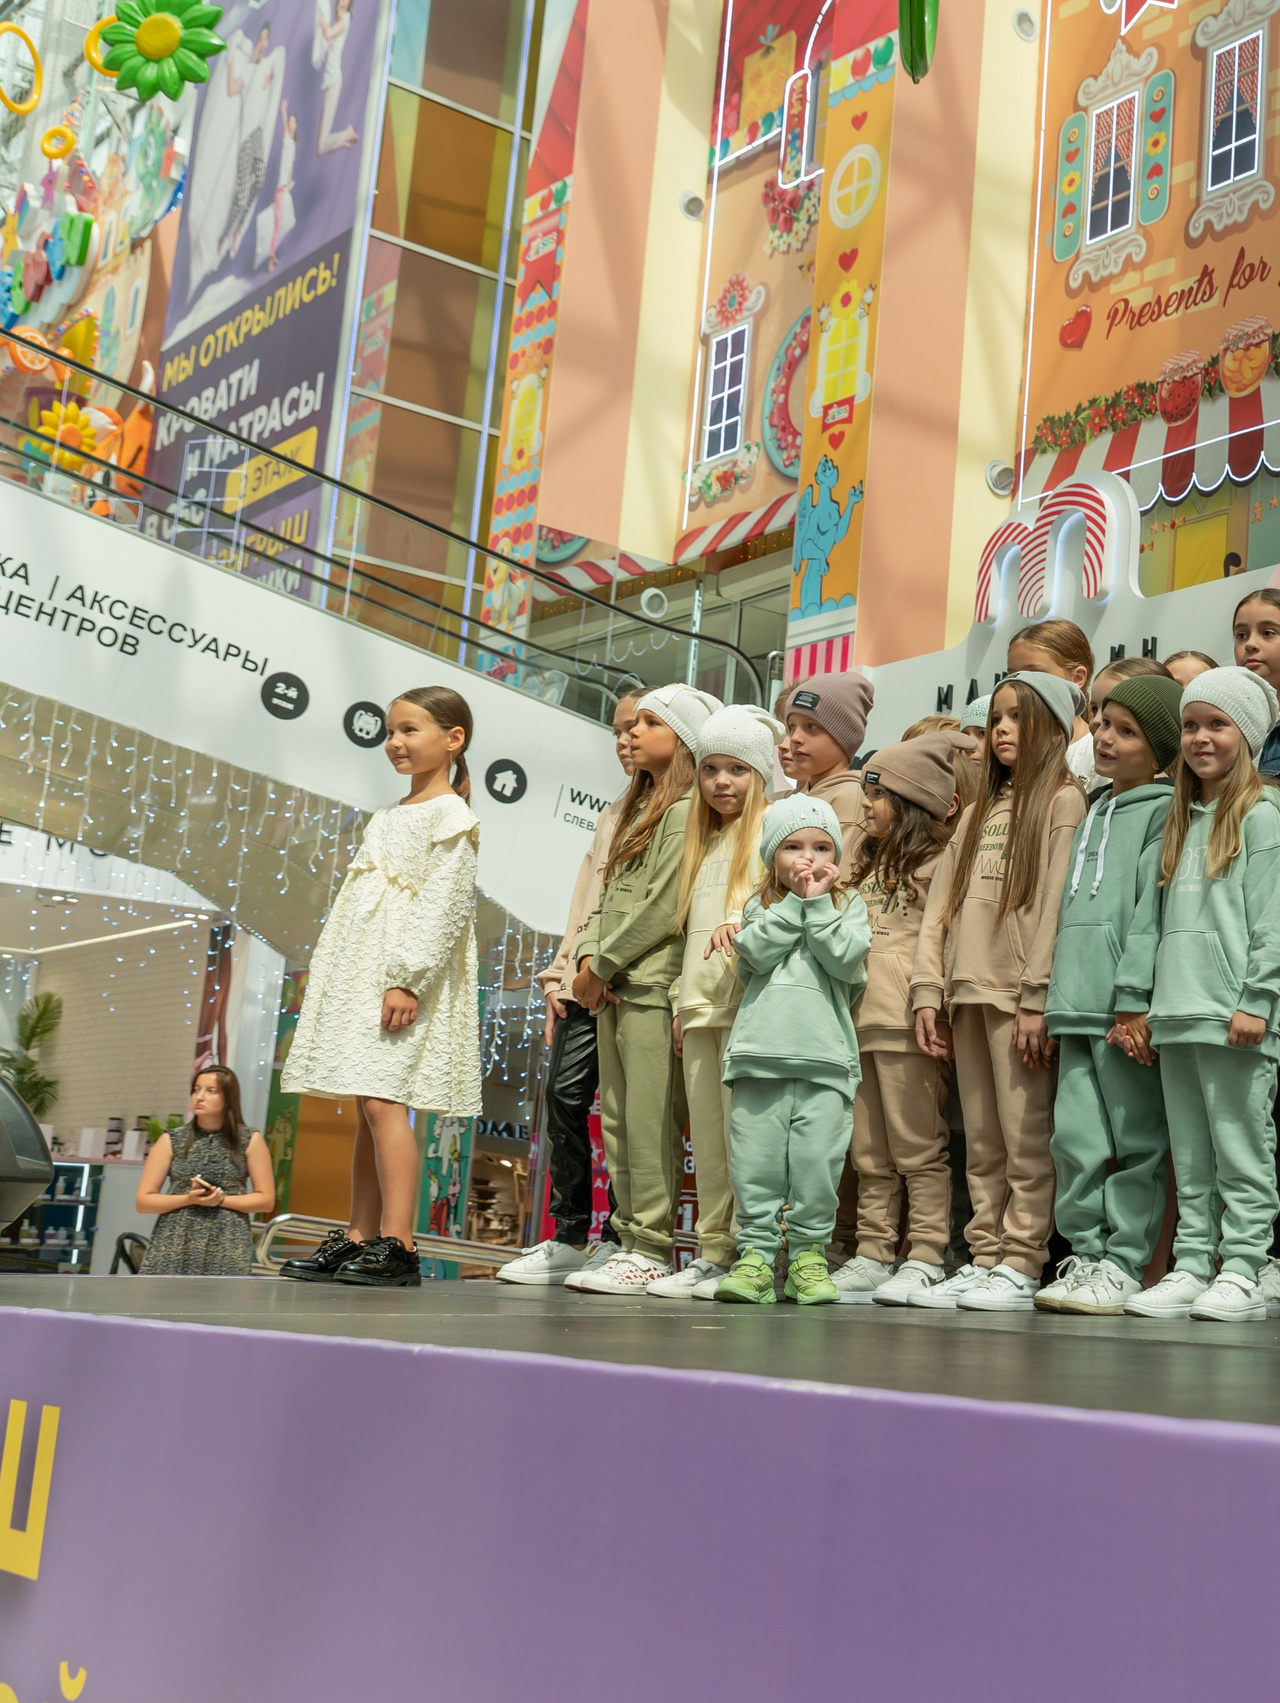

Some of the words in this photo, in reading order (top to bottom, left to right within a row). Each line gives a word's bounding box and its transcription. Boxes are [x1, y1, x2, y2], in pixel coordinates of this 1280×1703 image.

[163, 345, 196, 392] МЫ
[199, 252, 340, 368] ОТКРЫЛИСЬ!
[1105, 264, 1218, 340] Presents
[1222, 246, 1272, 308] for
[155, 357, 260, 452] КРОВАТИ
[203, 371, 325, 472] МАТРАСЫ
[66, 583, 269, 677] АКСЕССУАРЫ
[563, 812, 597, 832] СЛЕВ
